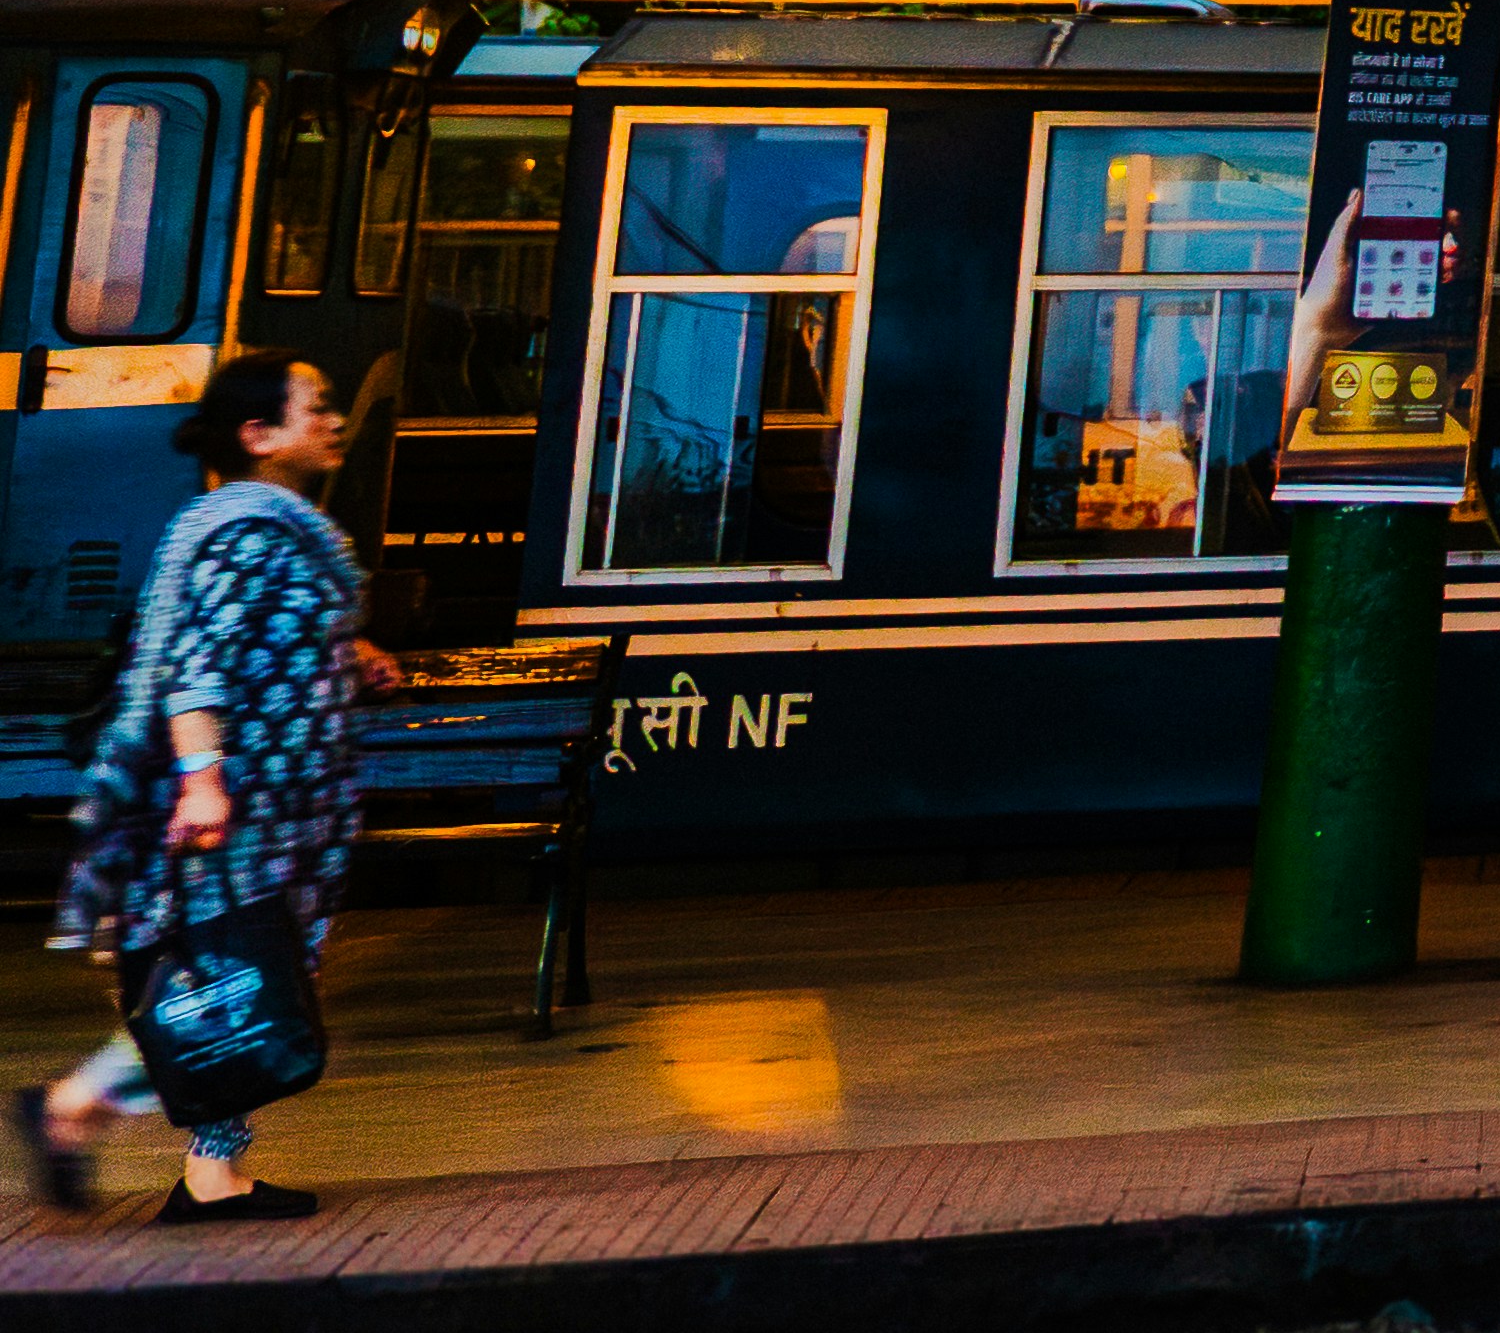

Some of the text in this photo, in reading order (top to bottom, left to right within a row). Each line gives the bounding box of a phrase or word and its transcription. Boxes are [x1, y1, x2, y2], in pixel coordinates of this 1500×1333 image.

[1350, 1, 1470, 45] याद रखें
[728, 693, 813, 749] NF
